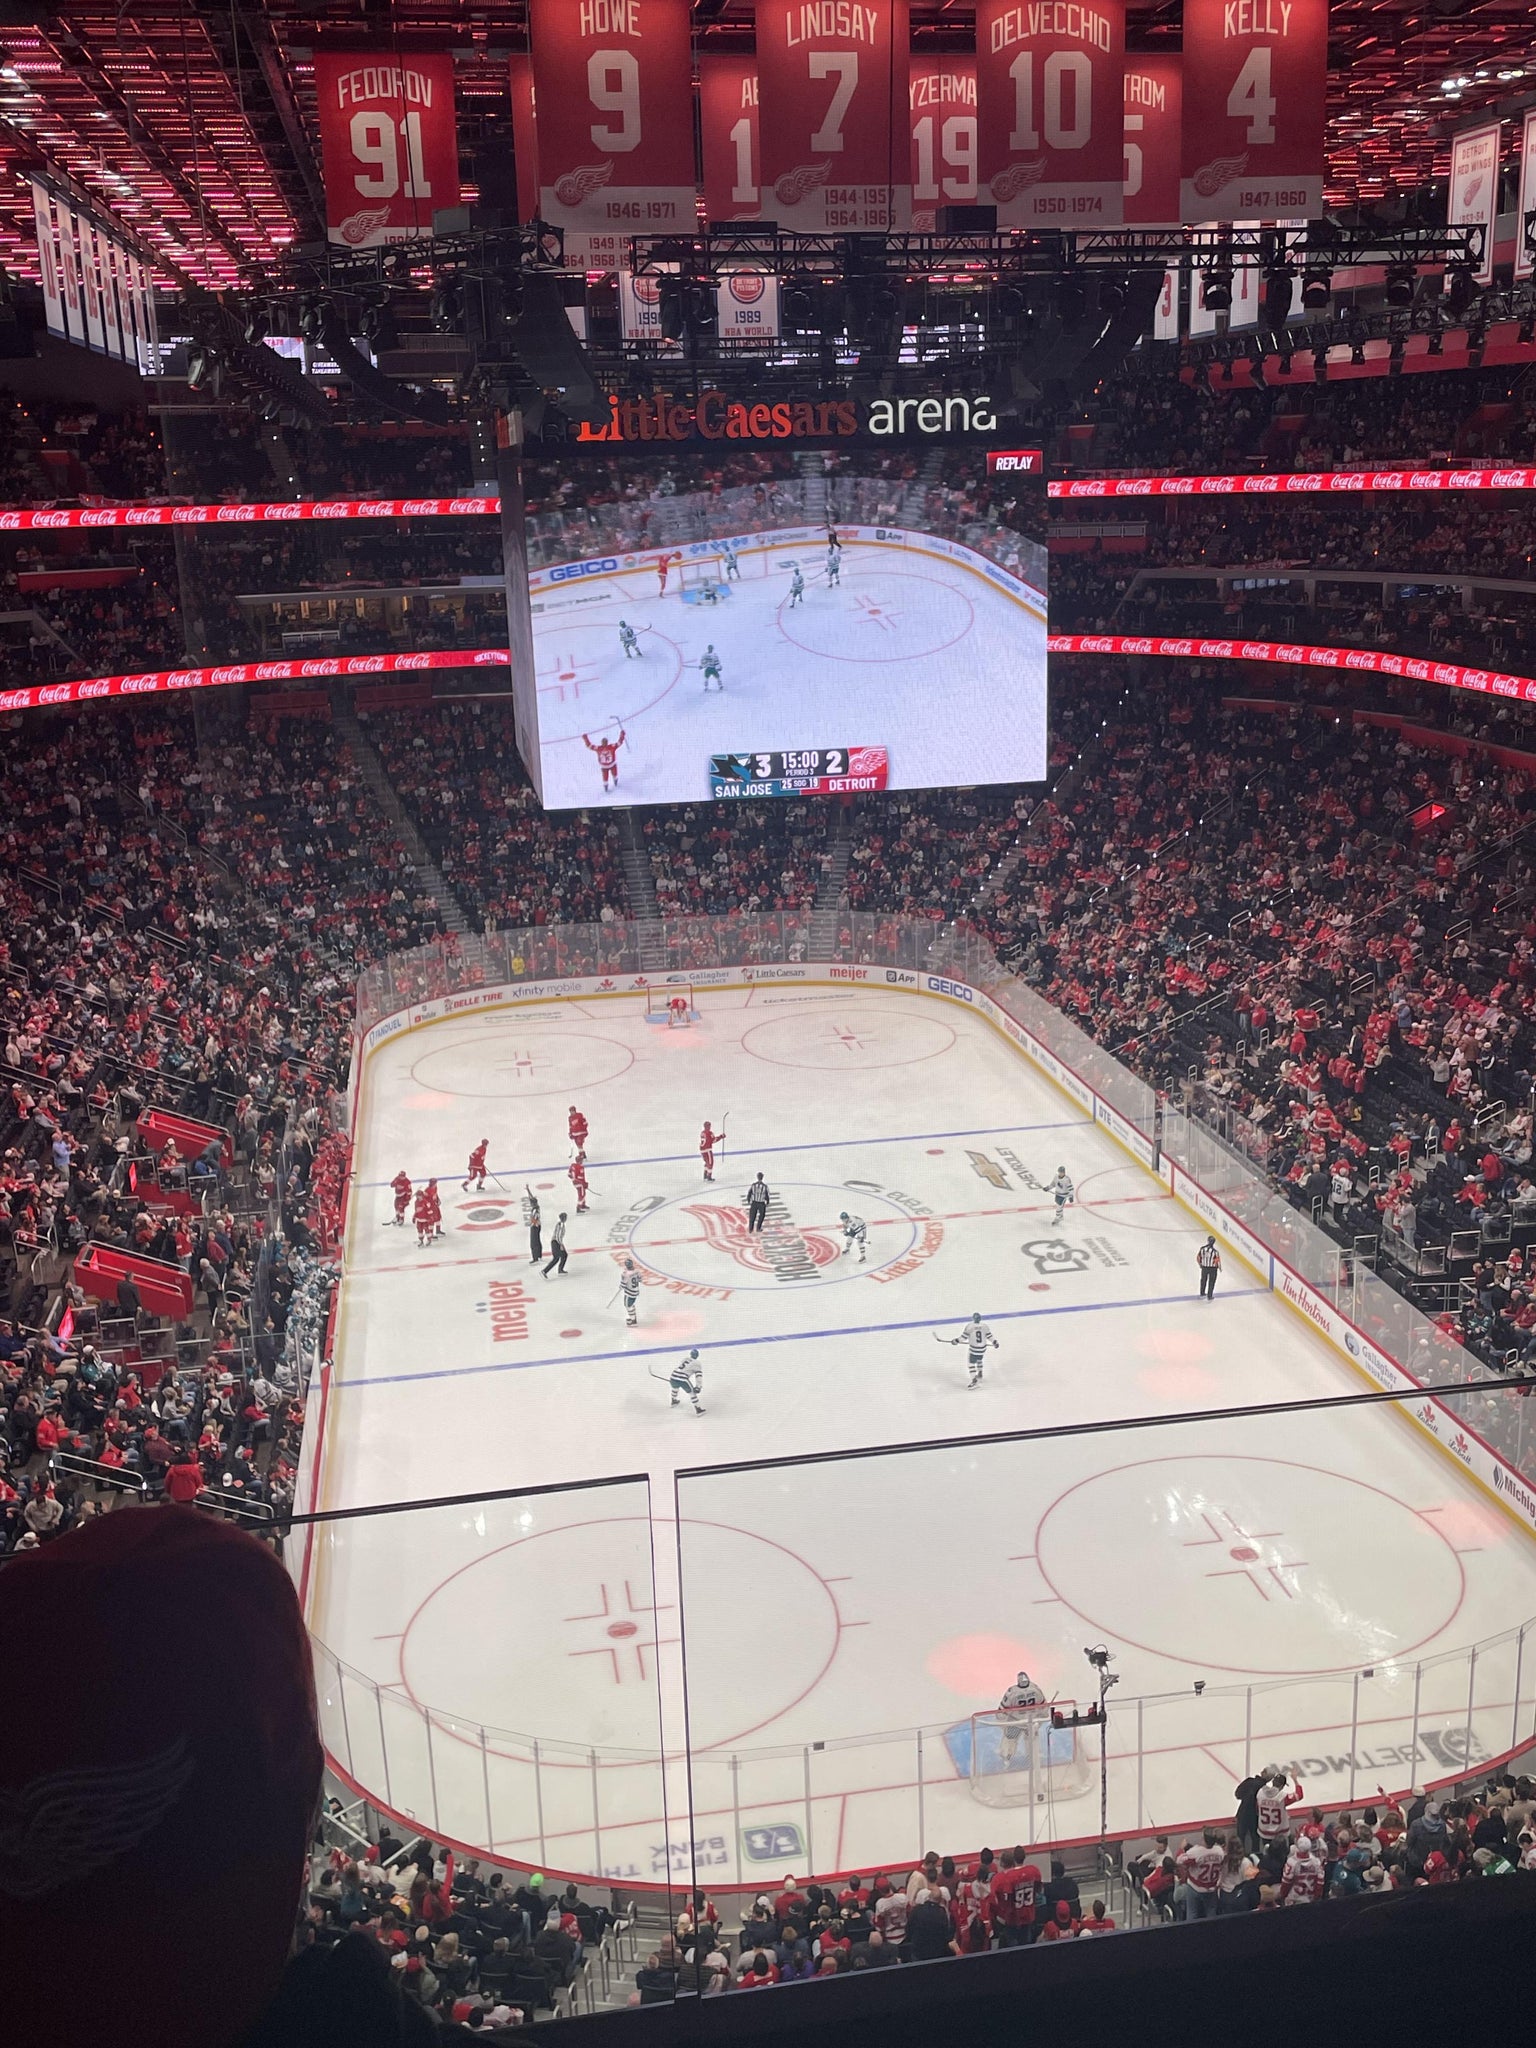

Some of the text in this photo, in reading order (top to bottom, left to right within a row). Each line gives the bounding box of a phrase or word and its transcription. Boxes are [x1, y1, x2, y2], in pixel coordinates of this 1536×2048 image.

[579, 0, 642, 37] HOWE
[786, 1, 878, 47] LINDSAY
[991, 2, 1111, 54] DELVECCHIO
[1224, 0, 1292, 38] KELLY
[337, 66, 432, 109] FEDOROV
[909, 74, 978, 110] YZERMA
[1123, 74, 1165, 112] TROM
[1227, 47, 1277, 144] 4
[587, 50, 642, 152] 9
[808, 51, 859, 152] 7
[1009, 51, 1092, 150] 10
[350, 111, 432, 198] 91
[912, 116, 978, 200] 19
[1462, 142, 1489, 160] DETROIT
[606, 202, 676, 218] 1946-1971
[1033, 197, 1102, 214] 1950-1974
[1240, 190, 1307, 207] 1947-1960
[564, 255, 584, 266] 964
[638, 312, 661, 325] 199
[735, 310, 761, 324] 1989
[725, 326, 773, 336] NBA WORLD
[576, 390, 997, 442] Little Caesars arena
[995, 456, 1034, 471] REPLAY
[549, 558, 617, 583] GEICO
[756, 754, 772, 778] 3
[781, 750, 819, 770] 15:00
[825, 750, 843, 774] 2
[781, 779, 793, 789] 25
[785, 769, 808, 777] PERIOD
[828, 776, 878, 792] DETROIT
[715, 783, 773, 798] SAN JOSE
[688, 971, 730, 981] Gallagher
[756, 968, 806, 979] Little Caesars
[829, 966, 868, 981] meijer
[453, 992, 503, 1009] BELLE TIRE
[512, 982, 583, 999] xfinity mobile
[927, 976, 973, 1002] GEICO
[994, 1146, 1043, 1191] CHEVROLET
[886, 1190, 935, 1216] arena
[864, 1221, 945, 1284] Little Caesars
[665, 1280, 735, 1301] Little
[1282, 1271, 1331, 1333] Tim Hortons
[475, 1280, 536, 1342] meijer
[1361, 1345, 1398, 1385] Gallagher
[1448, 1438, 1473, 1466] Labatt
[1504, 1475, 1536, 1519] Michig
[1267, 1743, 1427, 1780] BETMGM
[1260, 1807, 1282, 1826] 53
[649, 1835, 726, 1860] BANK
[652, 1851, 729, 1874] FIFTH
[1015, 1887, 1035, 1909] 93
